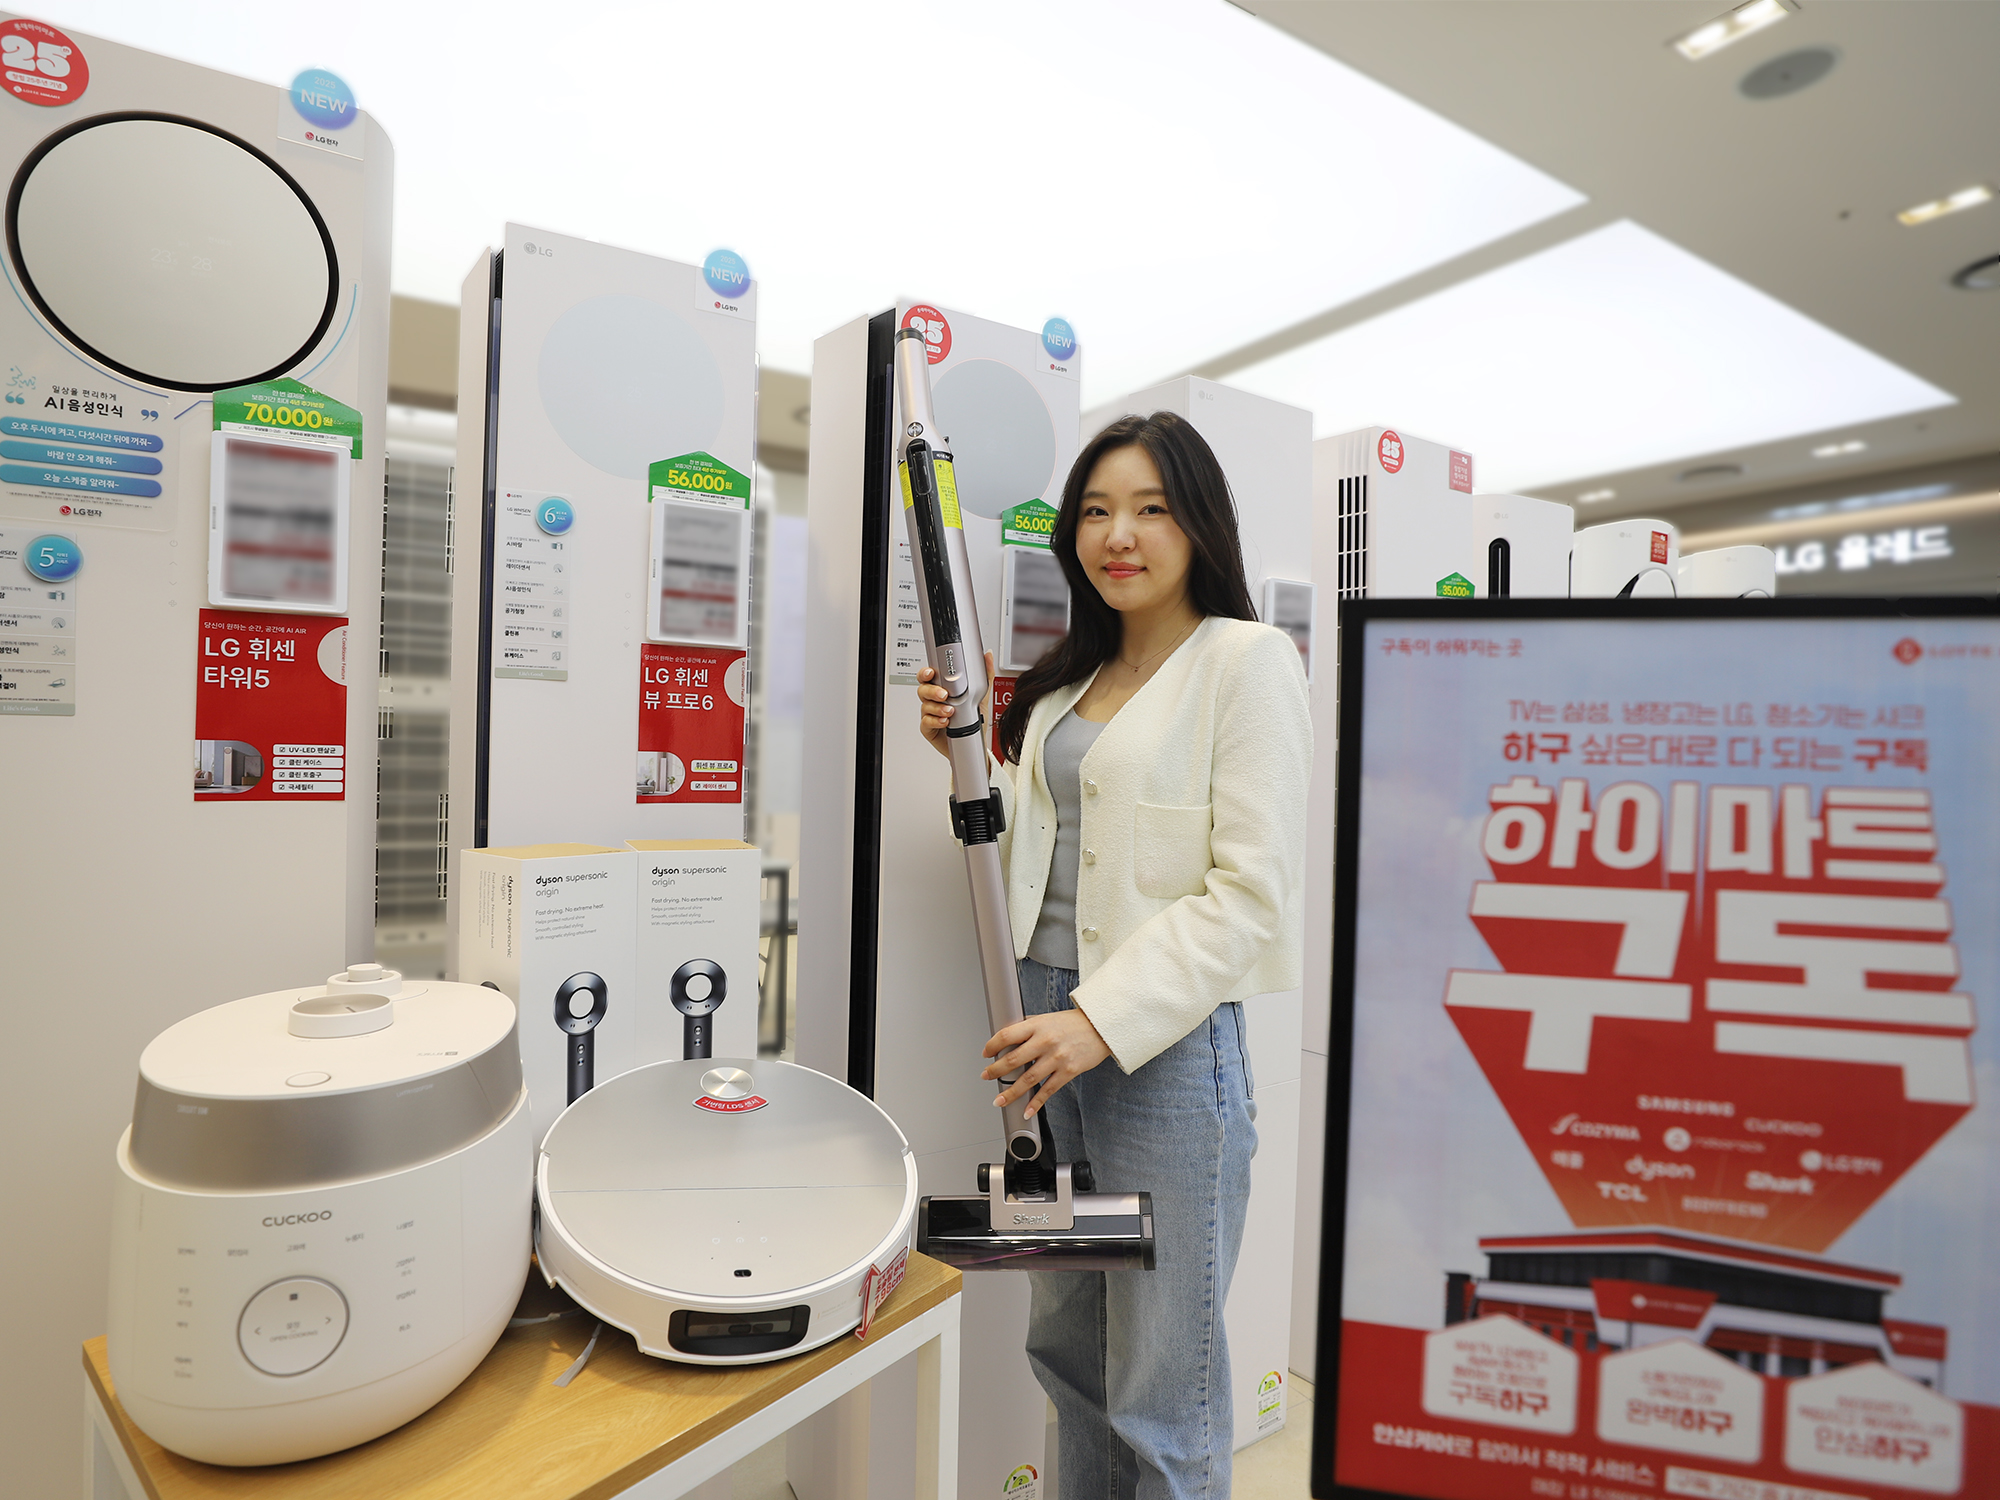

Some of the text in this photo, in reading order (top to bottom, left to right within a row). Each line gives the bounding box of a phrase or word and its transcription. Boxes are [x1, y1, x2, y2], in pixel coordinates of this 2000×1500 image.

[314, 76, 336, 91] 2025
[301, 88, 347, 114] NEW
[538, 246, 553, 257] LG
[711, 266, 744, 284] NEW
[1047, 333, 1072, 349] NEW
[52, 385, 117, 401] 일상을 편리하게
[11, 422, 29, 431] 오후
[30, 424, 57, 436] 두시에
[78, 430, 112, 443] 다섯시간
[47, 450, 65, 460] 바람
[66, 451, 75, 461] 안
[76, 453, 94, 464] 오게
[43, 473, 61, 483] 오늘
[62, 475, 88, 486] 스케줄
[544, 507, 556, 524] 6
[39, 548, 55, 569] 5
[1775, 541, 1824, 575] LG
[204, 622, 225, 630] 당신이
[226, 623, 247, 631] 원하는
[265, 626, 285, 634] 공간에
[205, 637, 295, 662] LG 휘센
[1381, 639, 1430, 657] 구독이
[945, 649, 956, 676] Shark
[204, 666, 270, 690] 타워5
[645, 667, 708, 688] LG 휘센
[644, 691, 714, 711] 뷰 프로6
[995, 691, 1013, 706] LG
[1623, 702, 1718, 726] 냉장고는
[1766, 705, 1867, 730] 청소기는
[1503, 733, 1928, 772] 하구 싶은대로 다 되는 구독
[303, 758, 322, 767] 케이스
[1482, 776, 1945, 884] 하이마트
[535, 871, 608, 887] dyson supersonic
[651, 866, 727, 878] dyson supersonic
[651, 878, 676, 888] origin
[535, 886, 559, 899] origin
[535, 909, 546, 917] Fast
[573, 904, 592, 912] extreme
[1443, 880, 1975, 1108] 구독
[745, 1098, 760, 1108] 센서
[1637, 1094, 1735, 1118] SAMSUNG
[1624, 1154, 1696, 1182] dyson
[1595, 1179, 1649, 1203] TCL
[262, 1210, 332, 1228] CUCKOO
[1013, 1213, 1050, 1226] Shark
